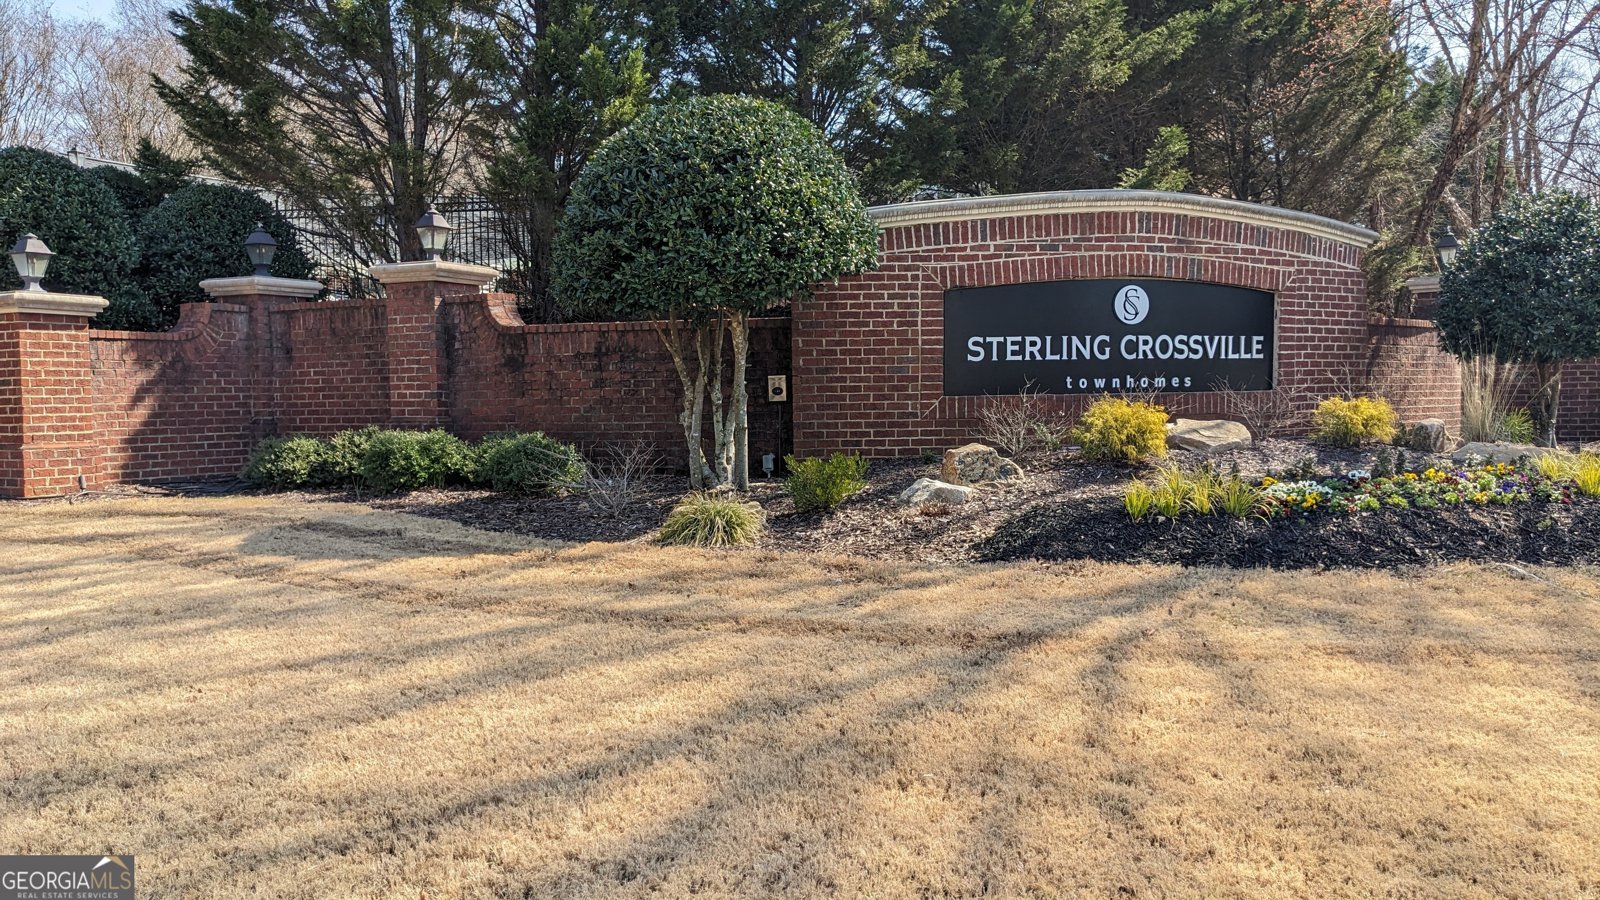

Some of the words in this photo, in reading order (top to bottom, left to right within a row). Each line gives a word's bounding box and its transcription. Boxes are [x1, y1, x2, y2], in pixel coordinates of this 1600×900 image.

[967, 335, 1110, 362] STERLING
[1120, 334, 1264, 360] CROSSVILLE
[1066, 374, 1192, 388] townhomes
